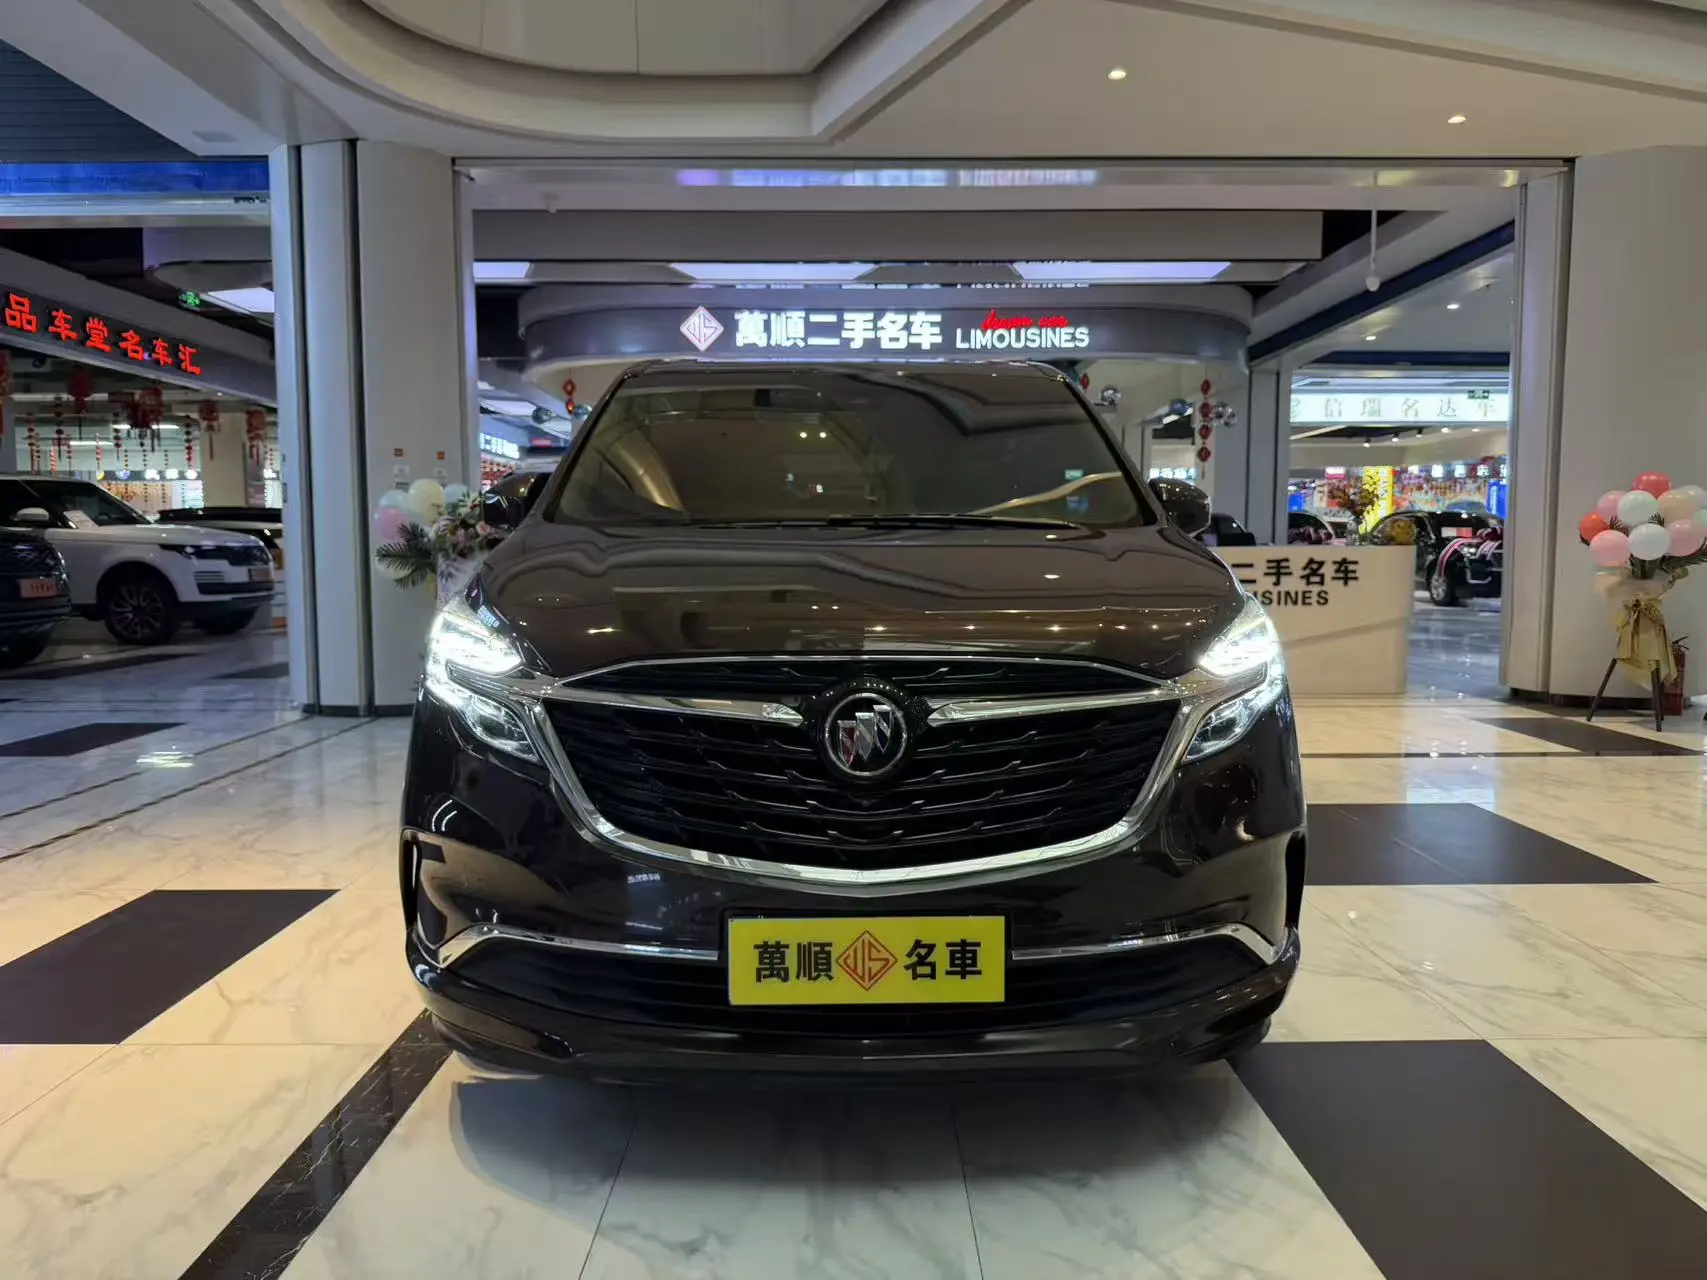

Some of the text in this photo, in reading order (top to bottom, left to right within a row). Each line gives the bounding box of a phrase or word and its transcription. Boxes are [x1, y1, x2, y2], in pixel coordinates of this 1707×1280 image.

[5, 292, 201, 376] 品车堂名车汇
[733, 310, 943, 351] 萬順二手名车
[955, 326, 1090, 350] LIMOUSINES
[1231, 557, 1359, 586] 二手名车
[753, 941, 834, 983] 萬順
[903, 939, 983, 980] 名車
